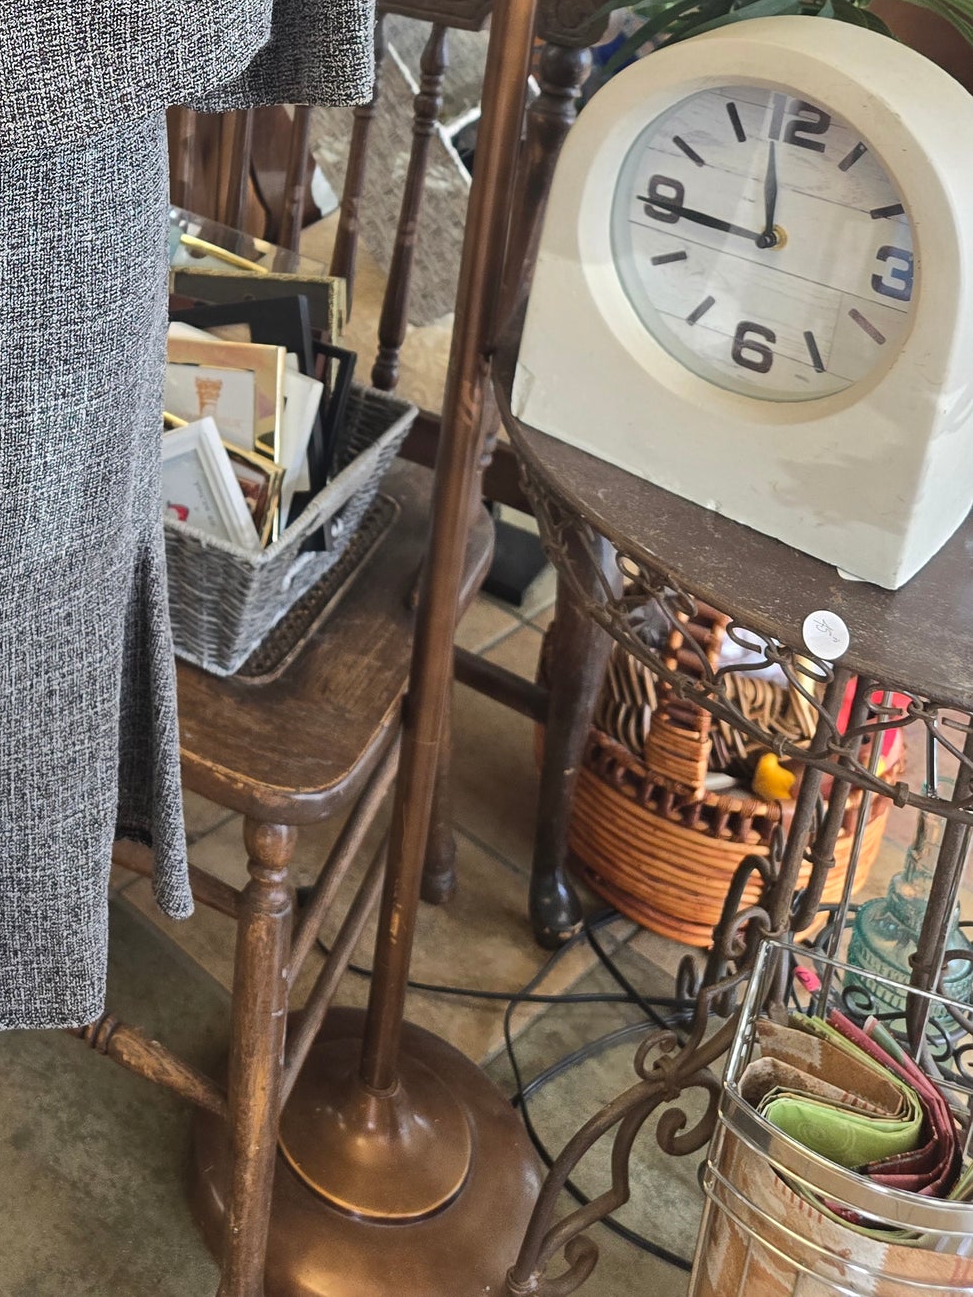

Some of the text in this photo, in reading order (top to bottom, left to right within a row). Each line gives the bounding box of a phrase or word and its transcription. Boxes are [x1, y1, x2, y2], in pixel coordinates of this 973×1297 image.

[767, 91, 832, 154] 12
[643, 173, 686, 225] 9
[871, 244, 915, 302] 3
[731, 319, 777, 374] 6
